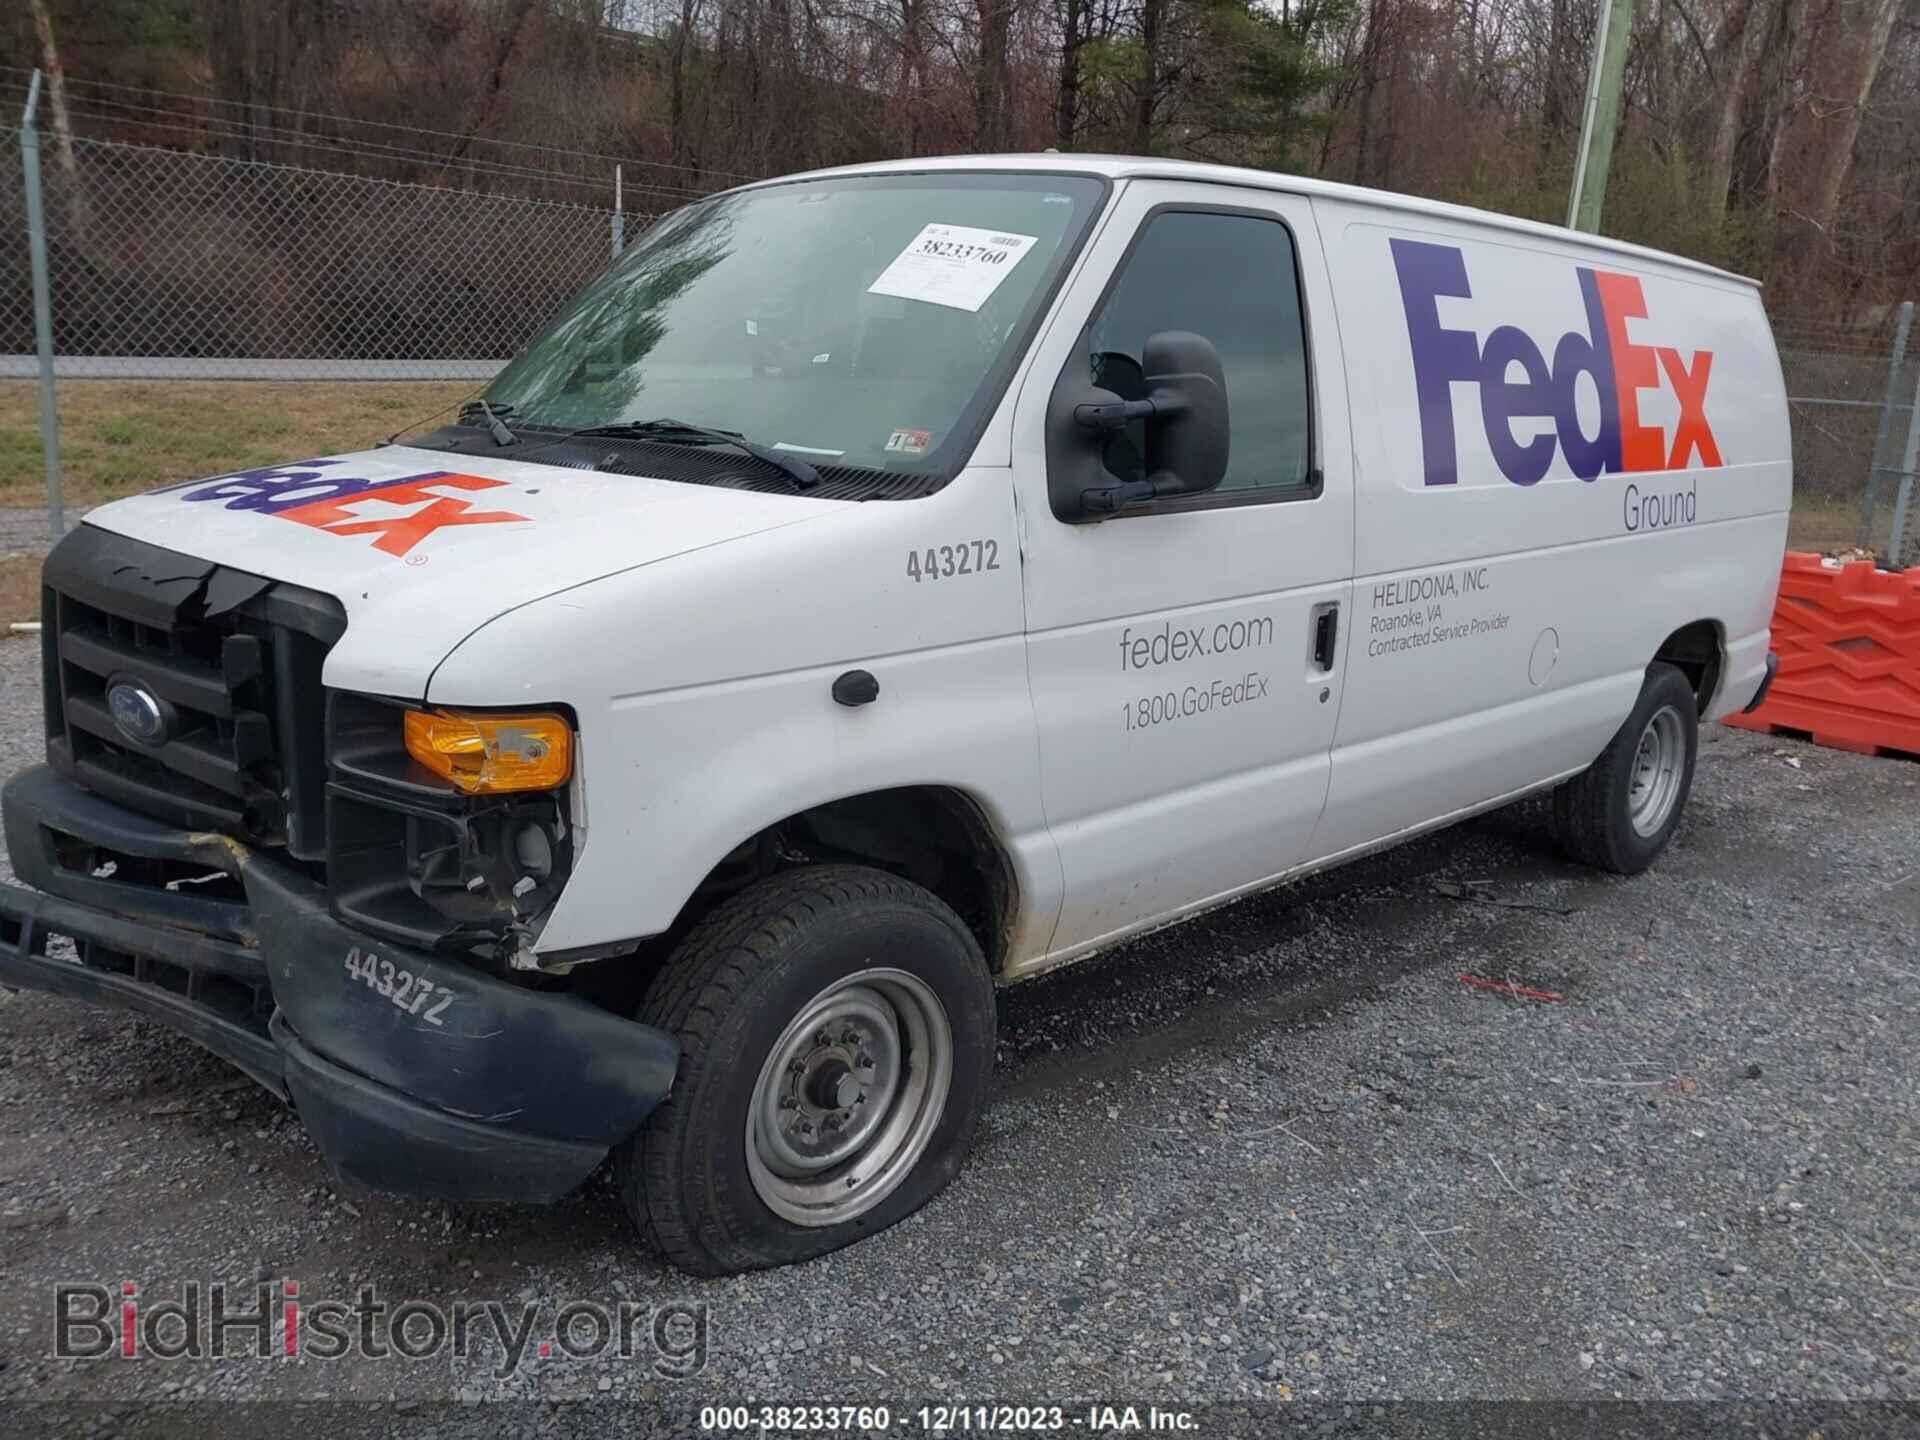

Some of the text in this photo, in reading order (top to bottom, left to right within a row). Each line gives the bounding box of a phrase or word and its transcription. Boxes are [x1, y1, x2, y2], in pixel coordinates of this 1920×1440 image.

[916, 239, 1008, 265] 38233760
[1388, 237, 1723, 487] FedEx
[1623, 479, 1697, 532] Ground
[906, 539, 1000, 583] 443272
[1372, 567, 1489, 609] HELIDONA, INC.
[1368, 613, 1510, 657] Contracted Service Provider
[1370, 604, 1443, 634] Roanoke, VA
[1119, 616, 1273, 671] fedex.com
[1122, 672, 1269, 731] 1.800.GoFedEx
[344, 946, 455, 1026] 443272
